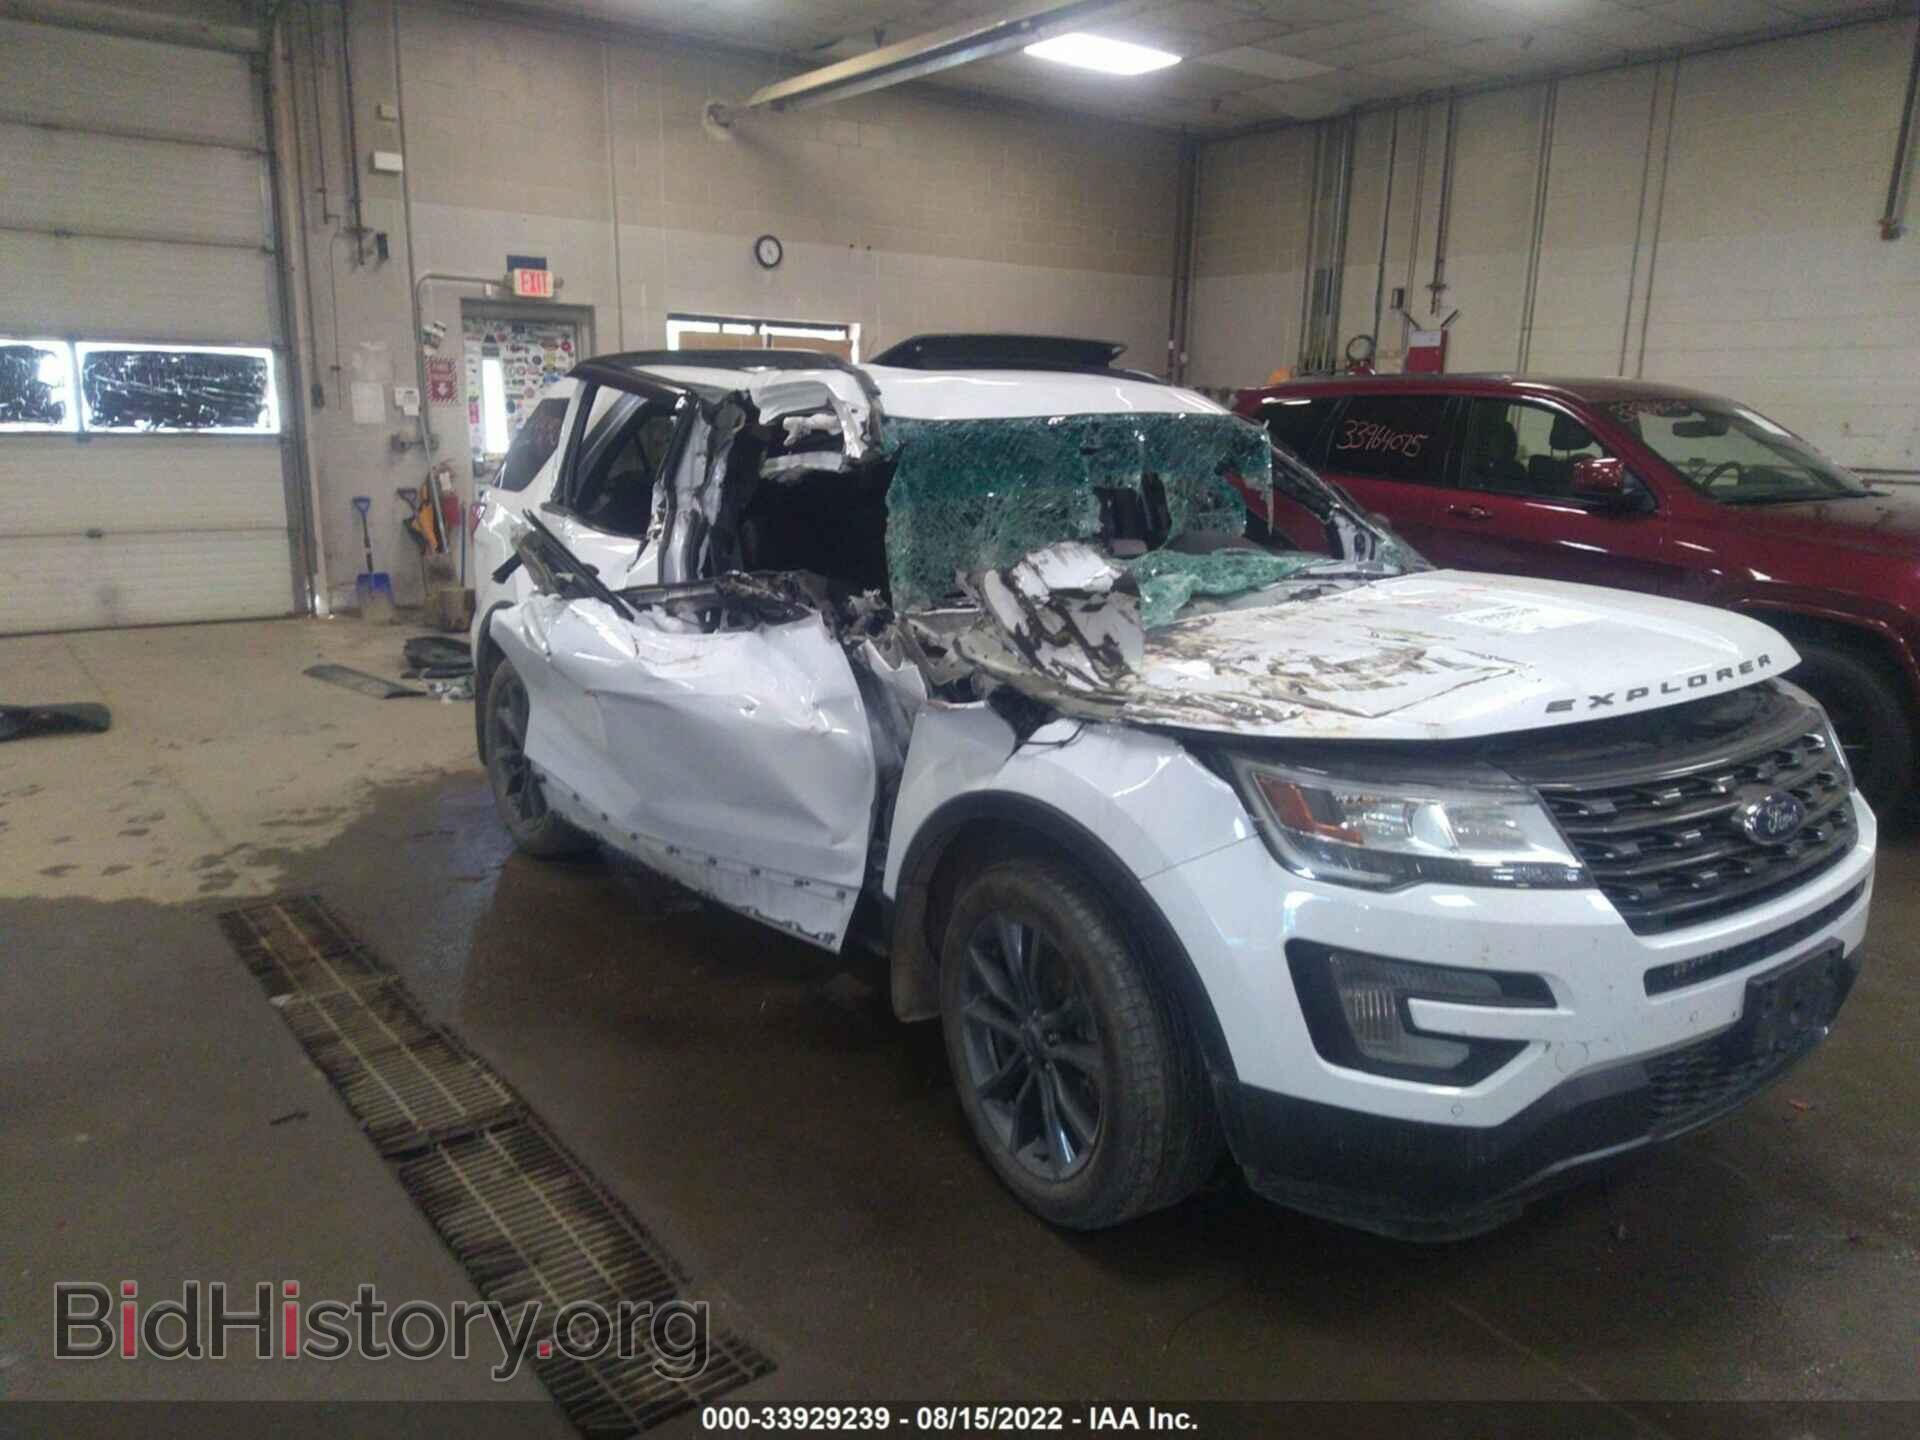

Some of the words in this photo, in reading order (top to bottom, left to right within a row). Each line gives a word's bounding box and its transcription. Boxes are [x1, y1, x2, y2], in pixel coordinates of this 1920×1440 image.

[519, 271, 549, 294] EXIT
[1545, 653, 1772, 714] EXPLORER
[1767, 800, 1798, 835] Ford
